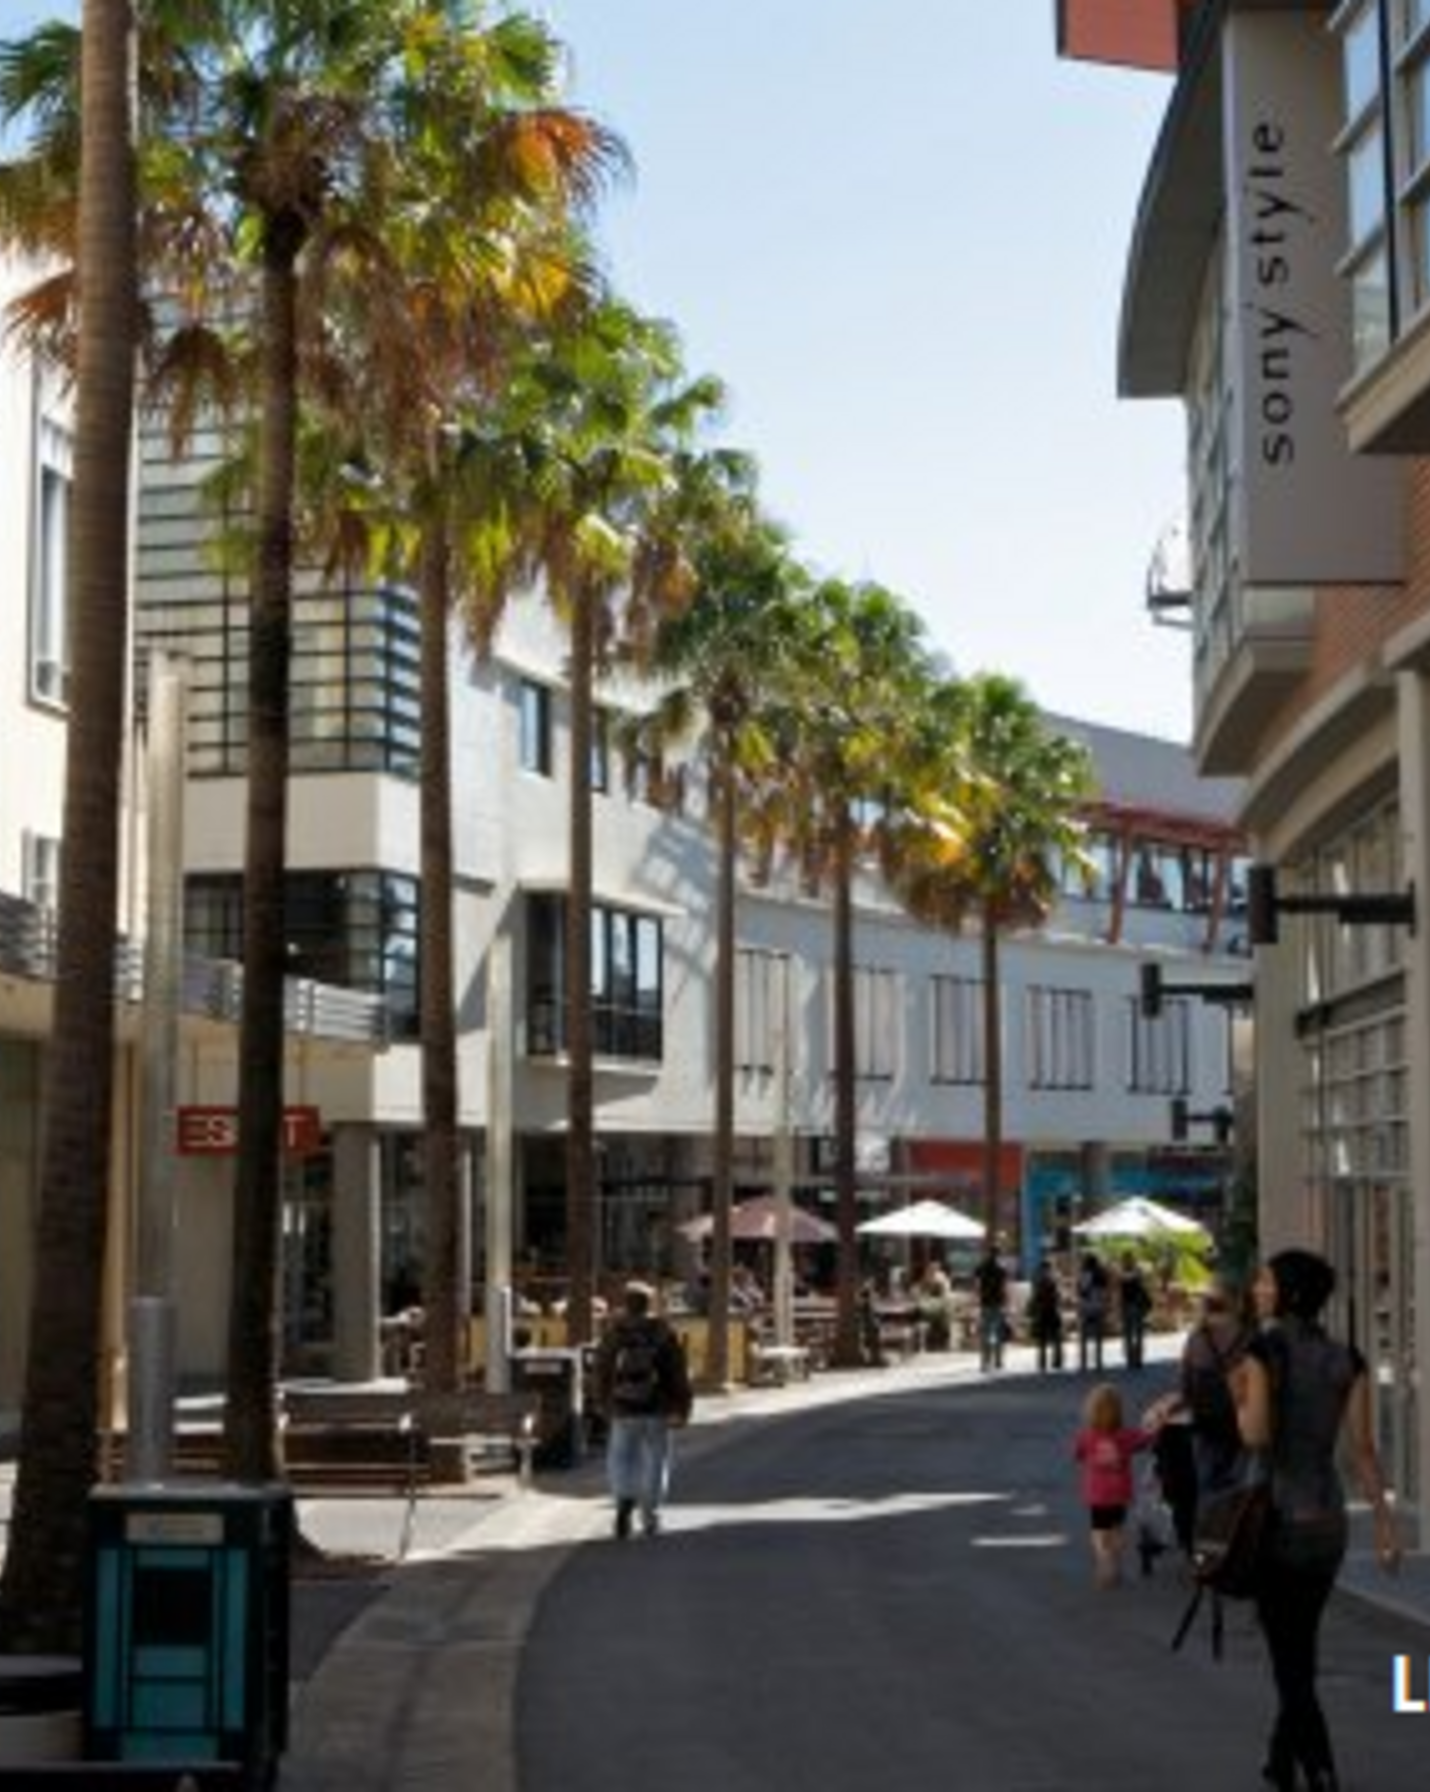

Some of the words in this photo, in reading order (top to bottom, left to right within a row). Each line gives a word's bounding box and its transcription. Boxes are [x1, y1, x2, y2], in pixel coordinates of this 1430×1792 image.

[1249, 123, 1316, 284] style
[1260, 308, 1320, 465] sony
[184, 1114, 307, 1148] EST
